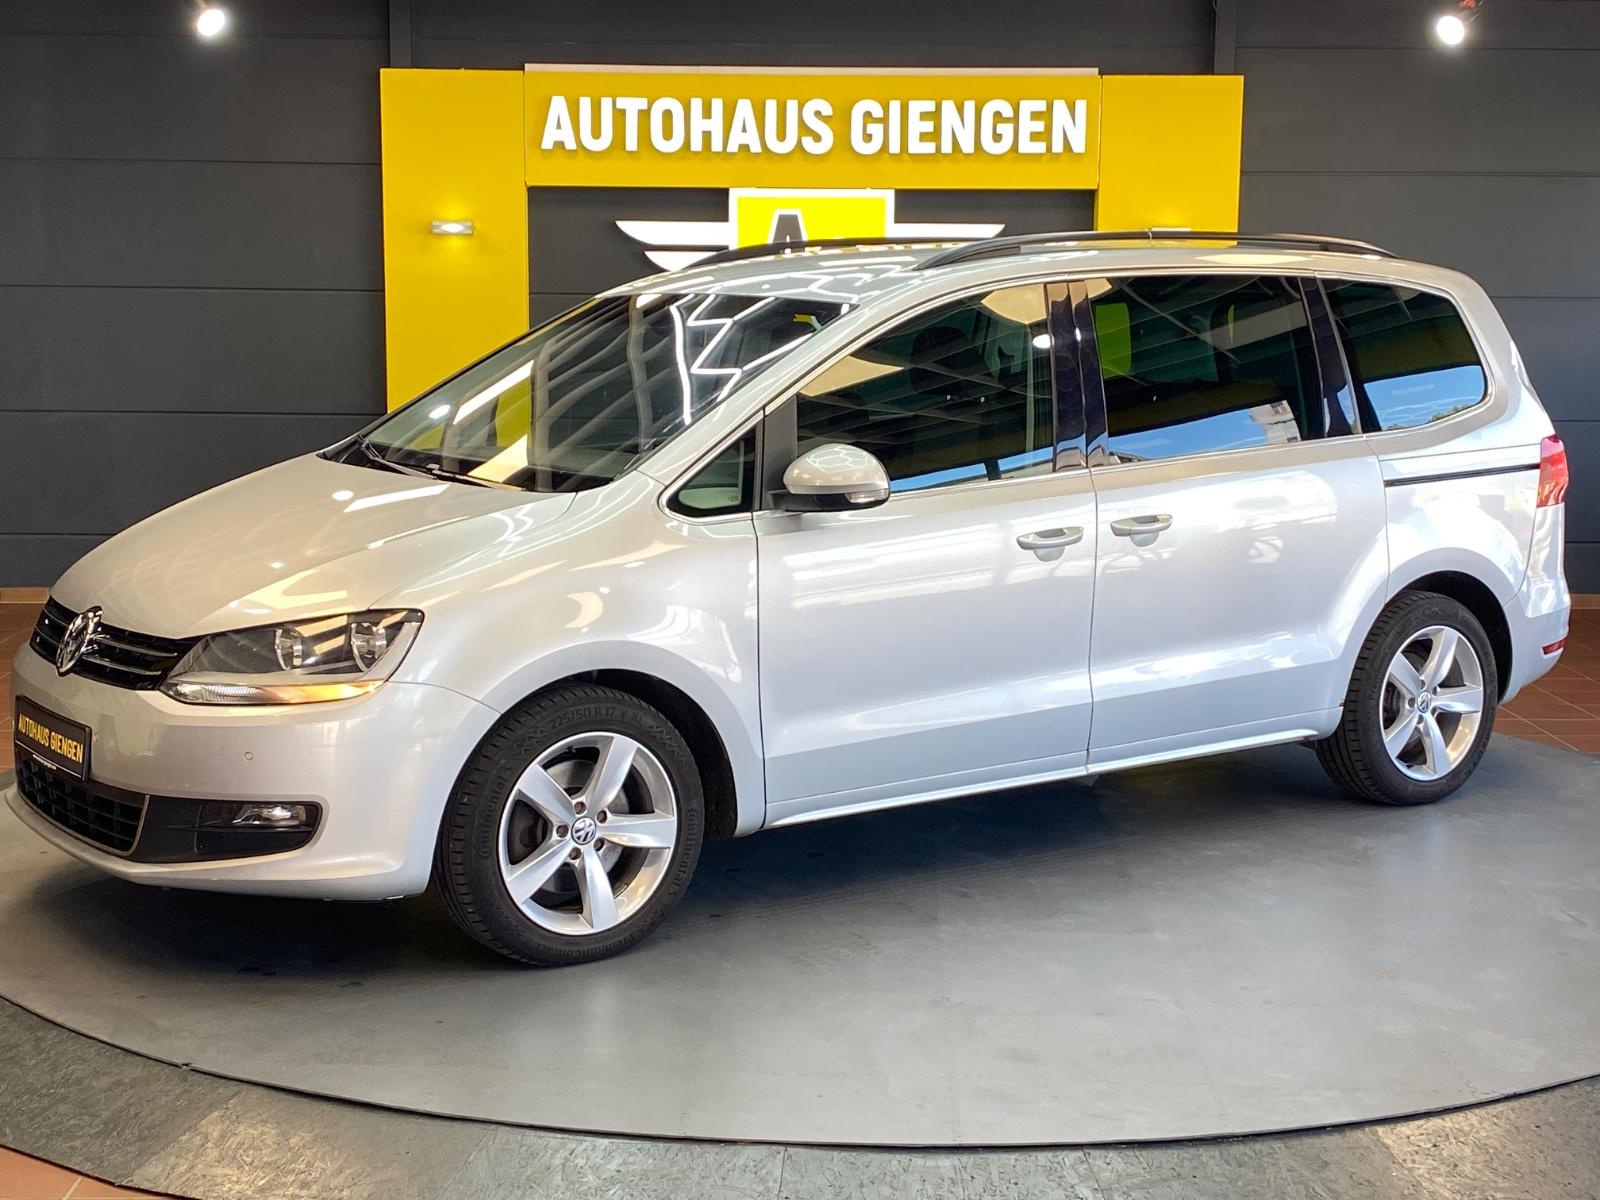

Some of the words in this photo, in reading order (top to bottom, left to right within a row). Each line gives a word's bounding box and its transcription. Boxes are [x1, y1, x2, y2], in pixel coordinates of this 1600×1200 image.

[541, 96, 833, 154] AUTOHAUS
[850, 99, 1086, 155] GIENGEN
[18, 713, 49, 747] AUTOHAUS
[50, 731, 84, 764] GIENGEN
[551, 706, 592, 730] 225/50
[605, 705, 617, 718] 17
[479, 775, 509, 859] Continental
[672, 807, 698, 887] Continental
